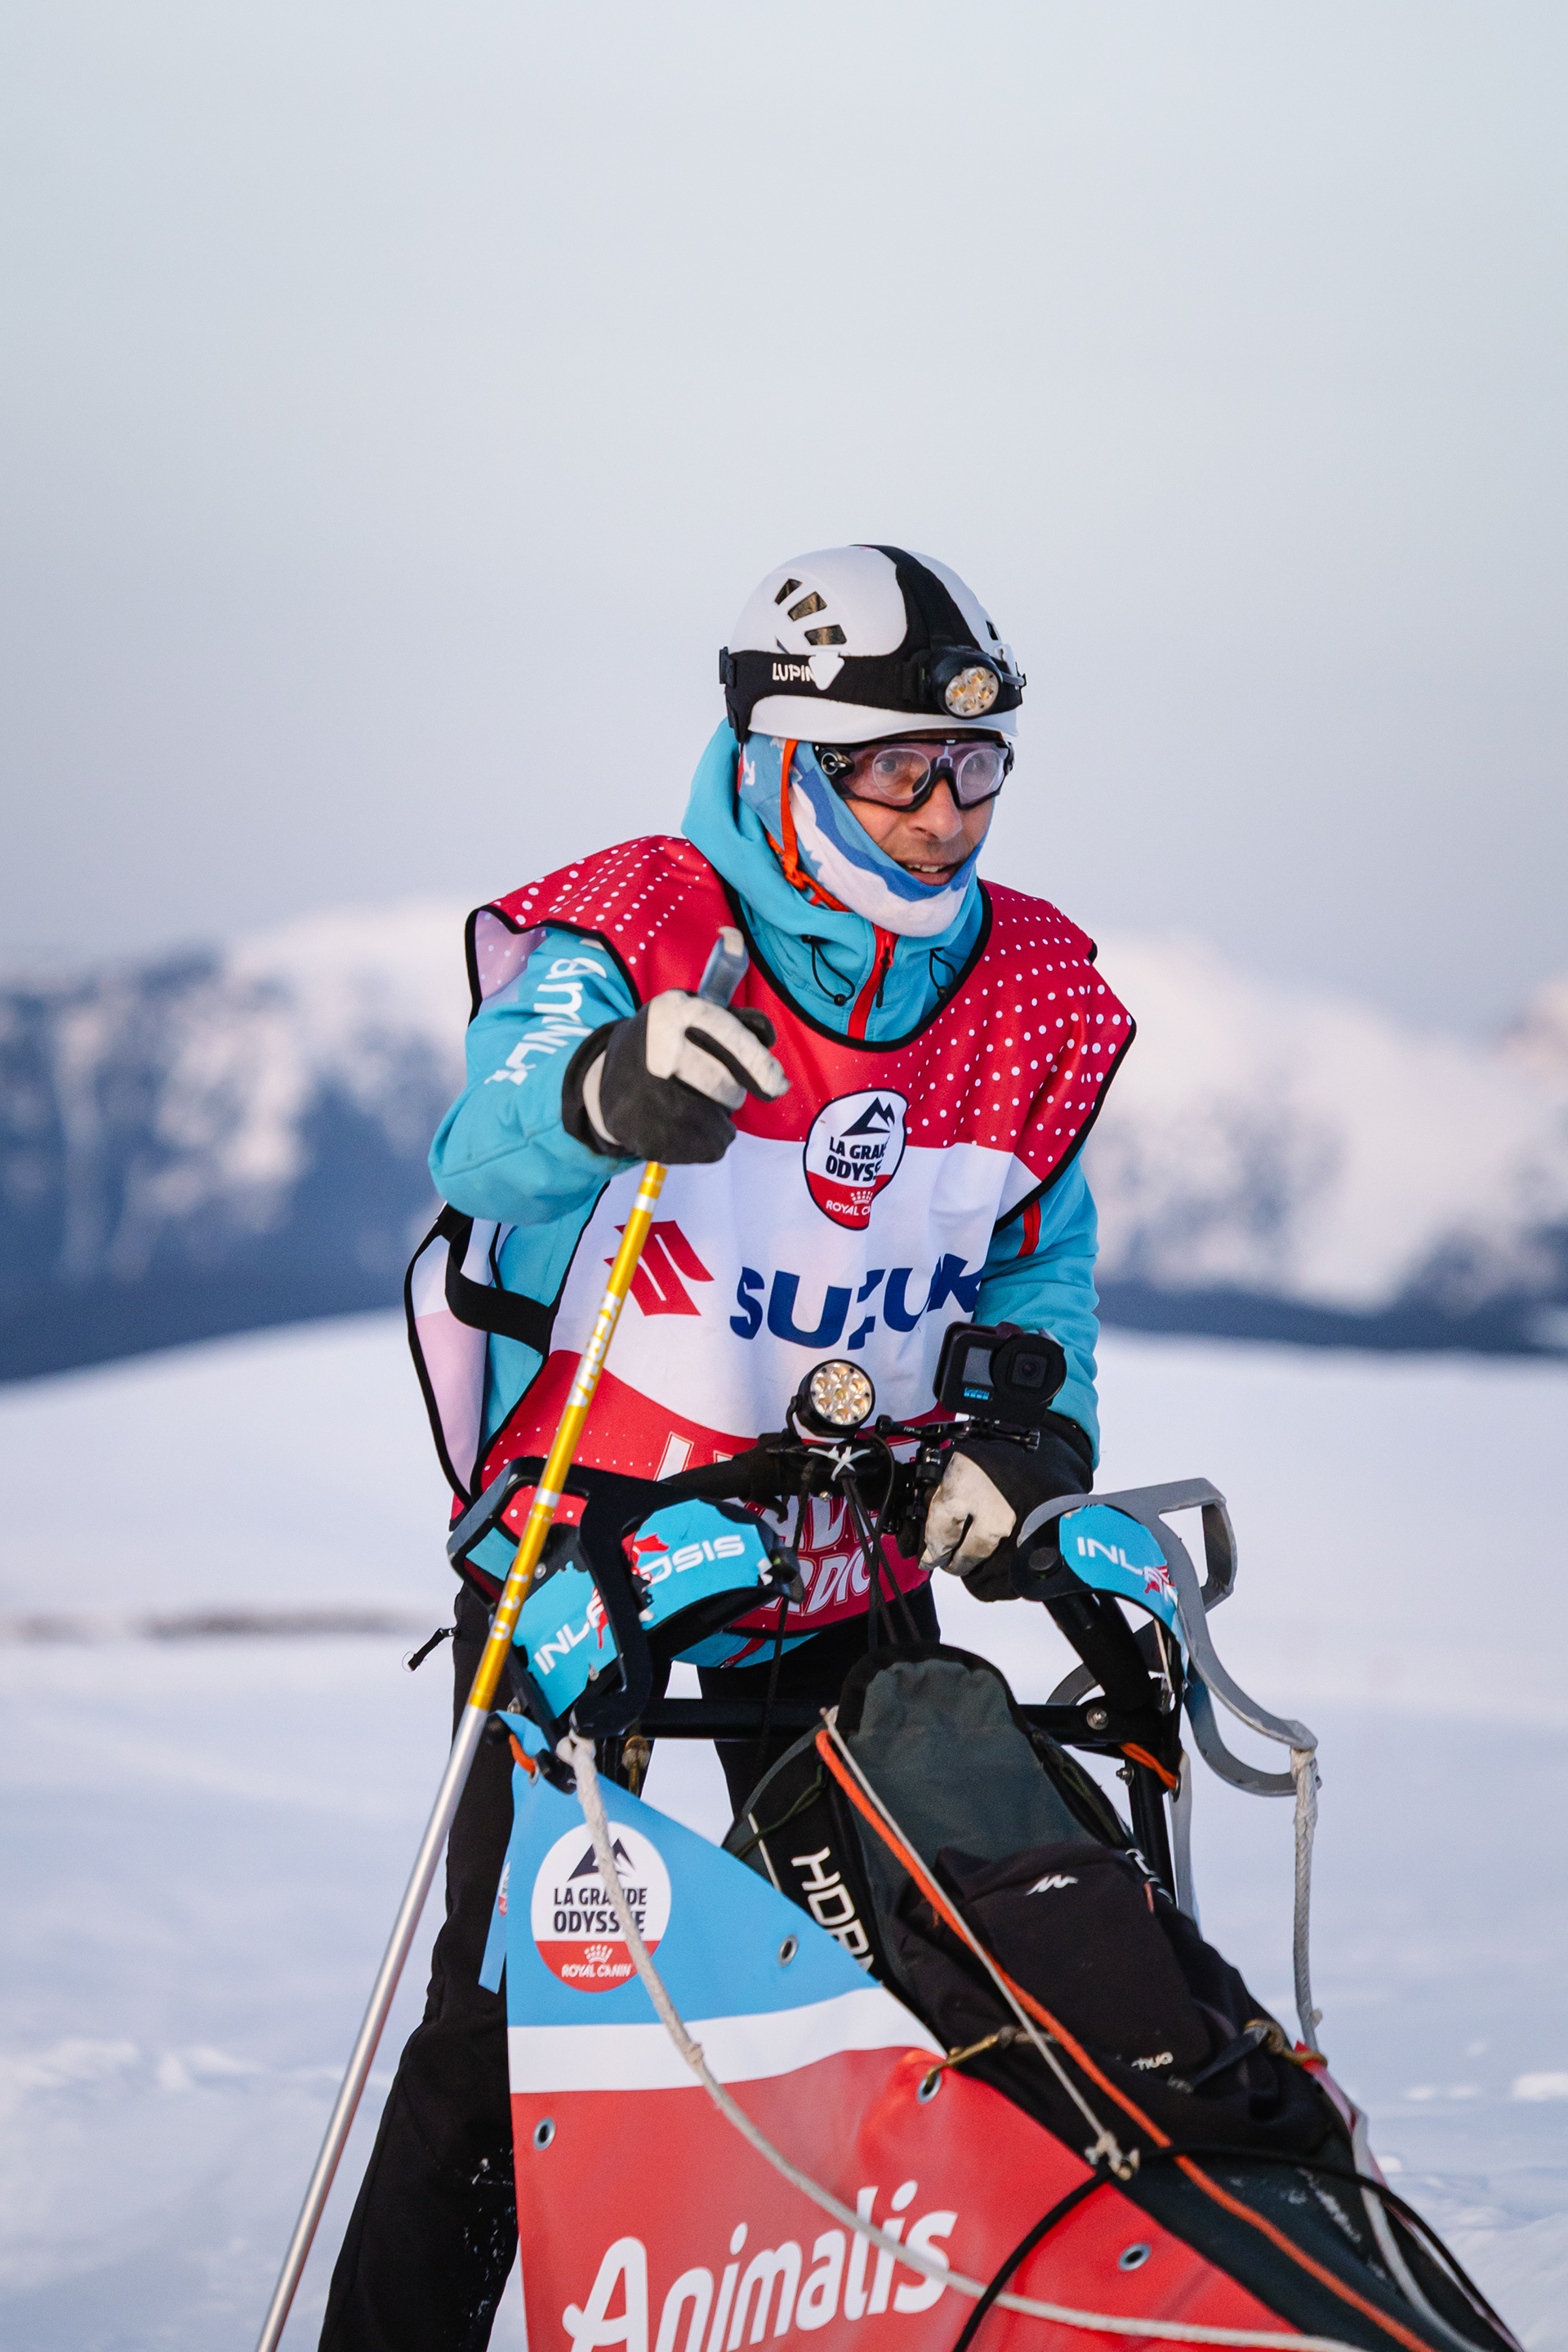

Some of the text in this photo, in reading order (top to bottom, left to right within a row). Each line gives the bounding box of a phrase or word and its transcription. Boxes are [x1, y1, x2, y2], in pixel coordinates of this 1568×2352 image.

[772, 662, 815, 682] LUPIN
[829, 1136, 845, 1157] LA
[826, 1200, 859, 1216] ROYAL
[729, 1253, 983, 1351] SUZUK
[554, 1887, 648, 1905] LA GRADE
[554, 1910, 646, 1933] ODYSSE
[561, 1963, 632, 1978] ROYAL CANIN
[562, 2180, 959, 2352] Animalis
